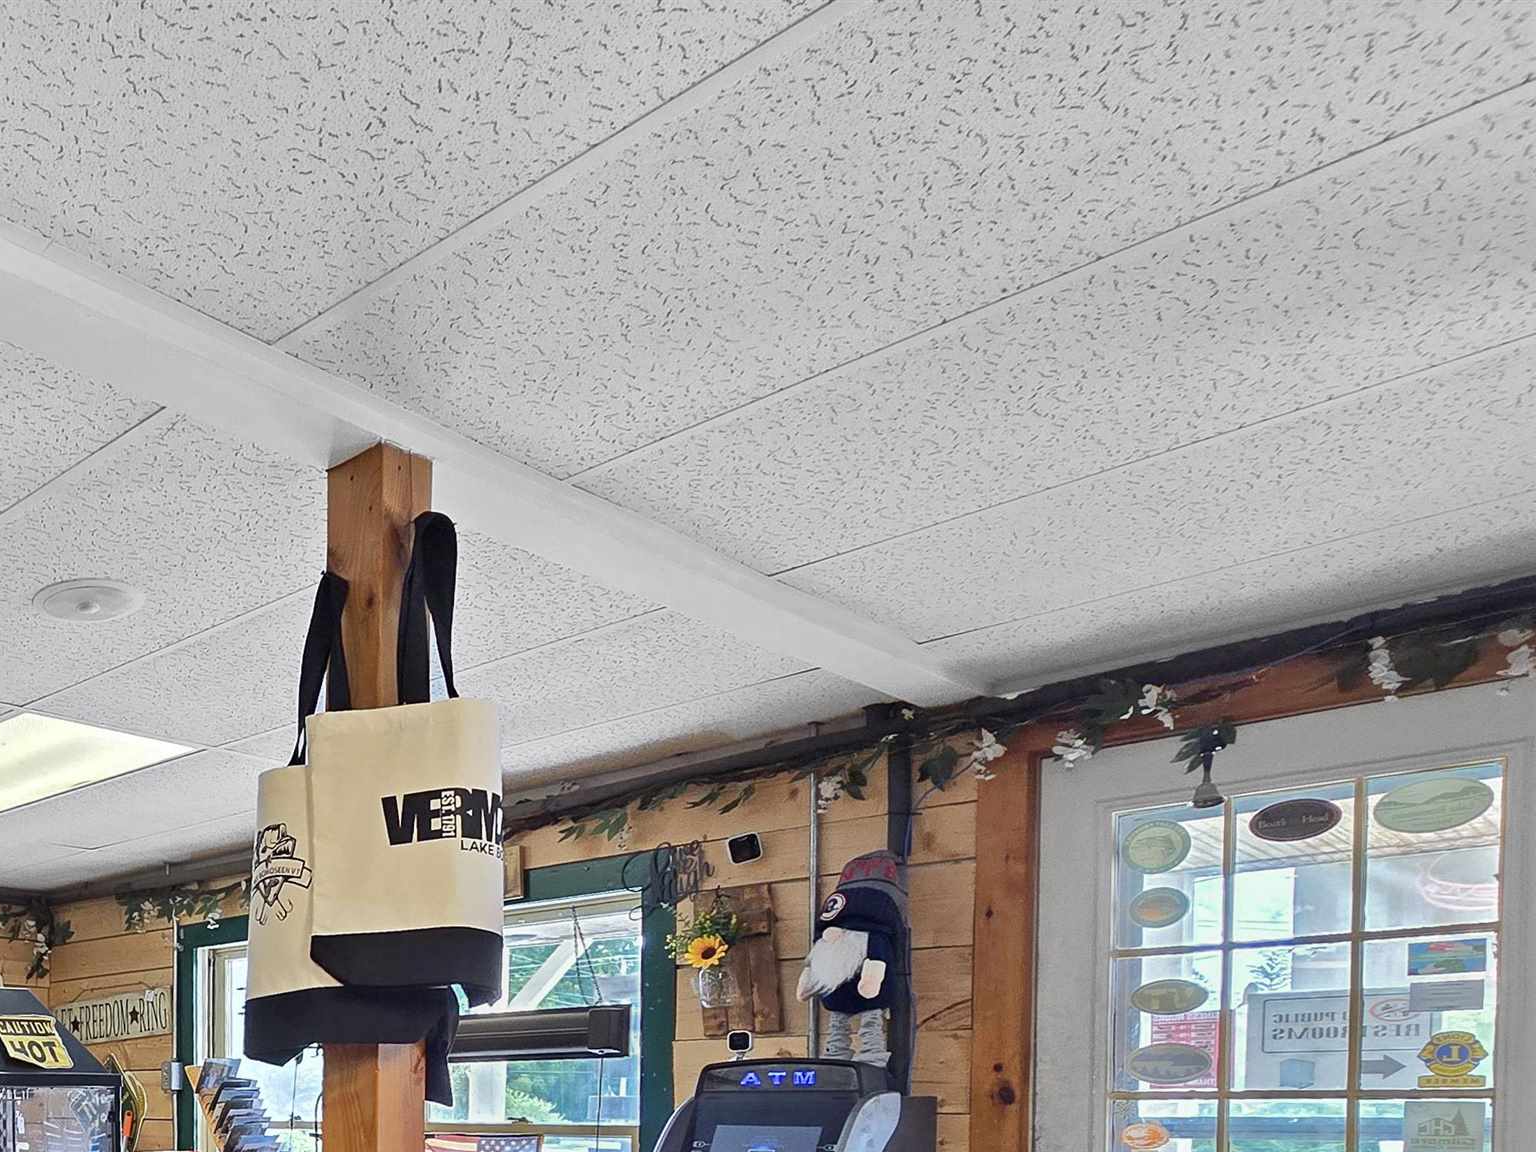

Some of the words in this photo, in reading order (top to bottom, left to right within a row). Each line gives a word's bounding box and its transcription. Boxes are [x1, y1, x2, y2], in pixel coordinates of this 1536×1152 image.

[460, 840, 495, 856] LAKE
[79, 999, 130, 1040] FREEDOM
[139, 991, 167, 1033] RING
[740, 1071, 817, 1086] ATM
